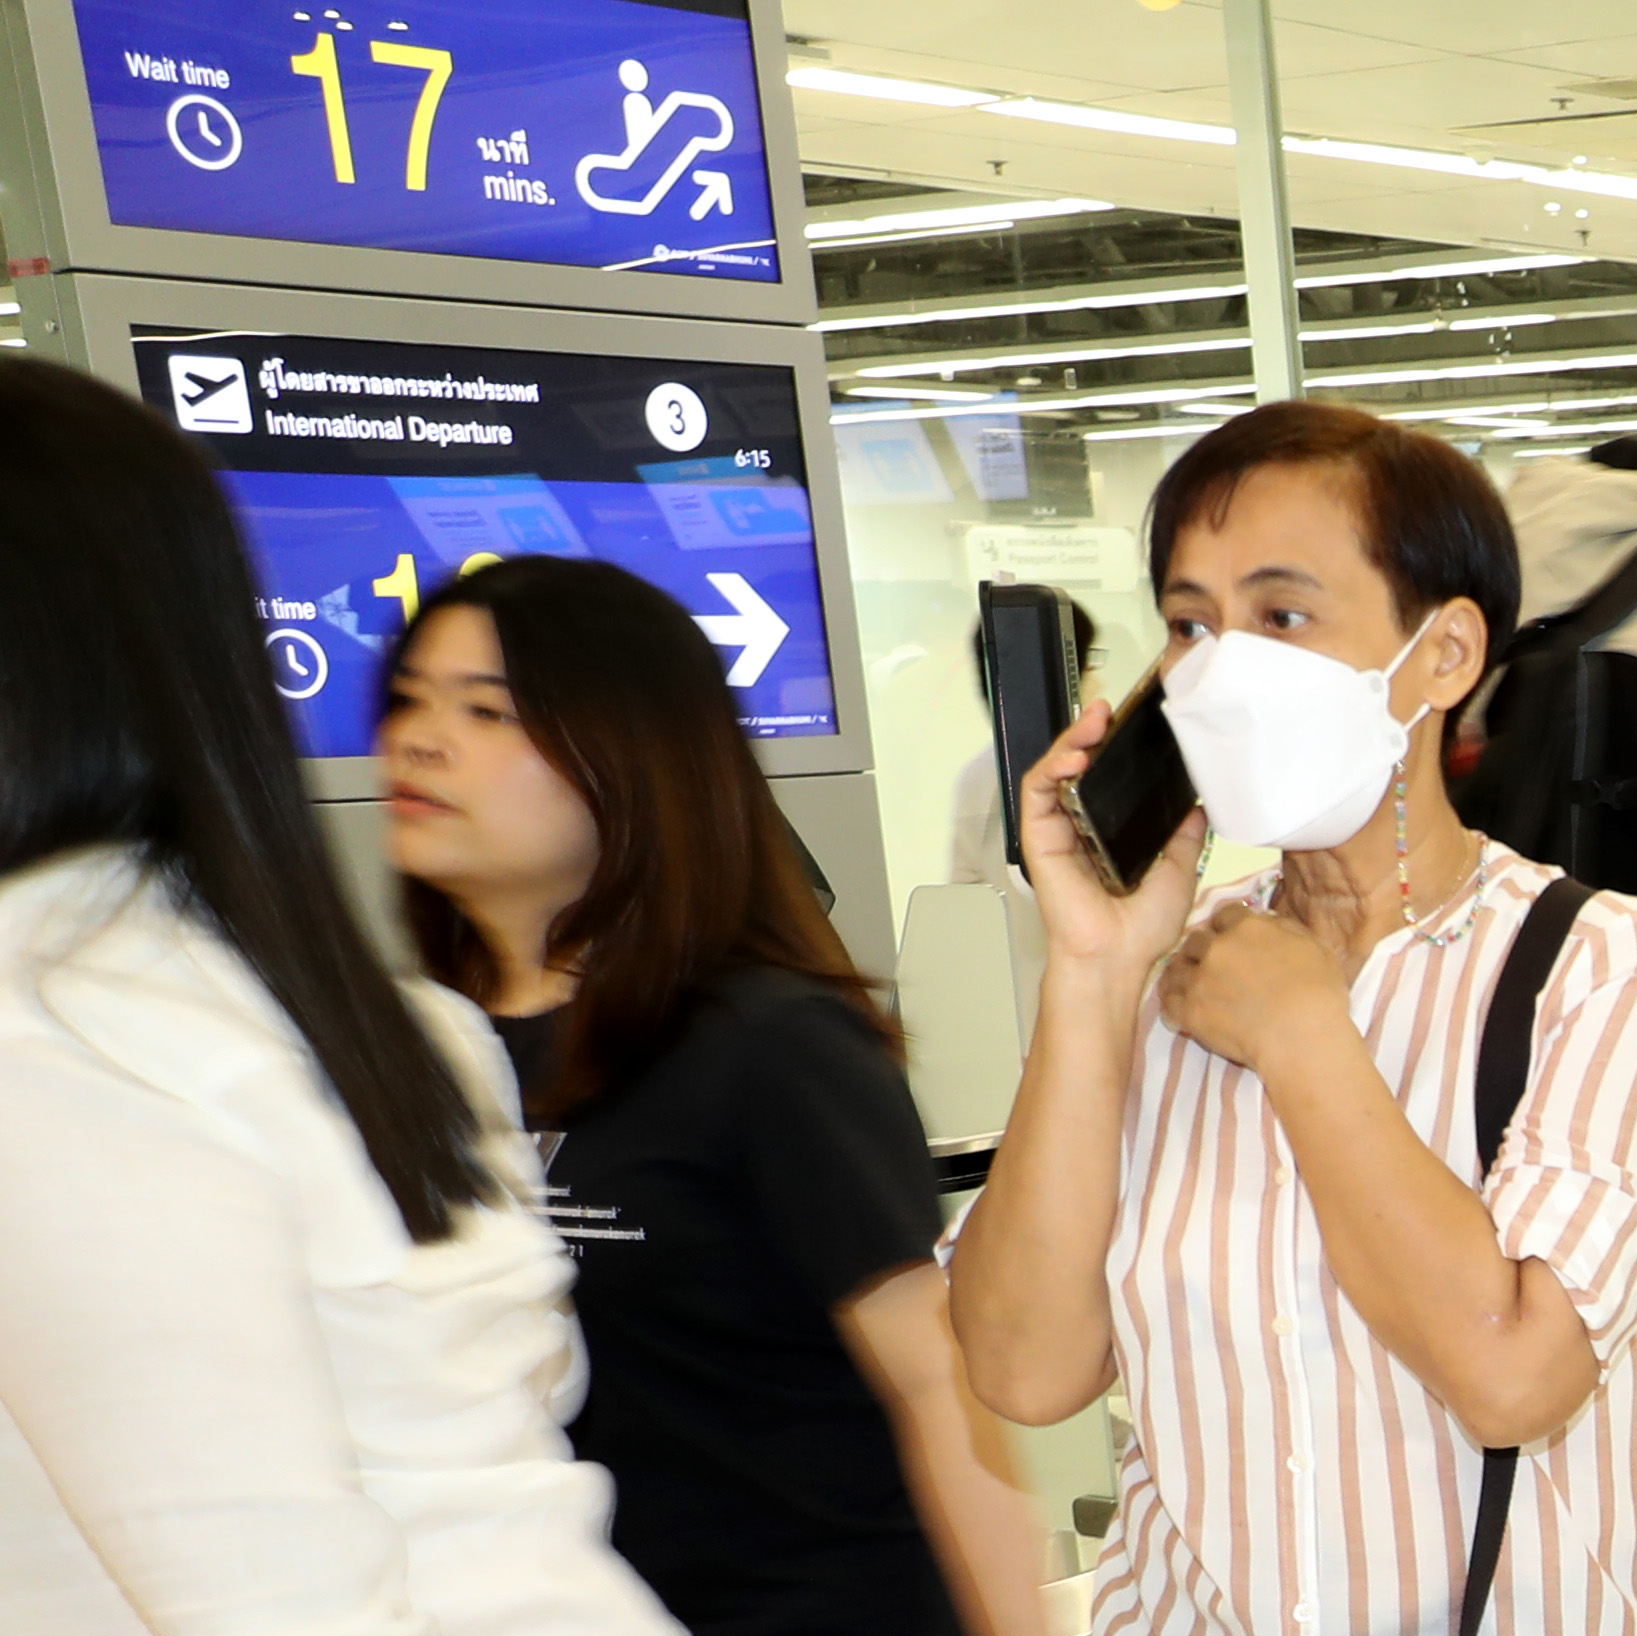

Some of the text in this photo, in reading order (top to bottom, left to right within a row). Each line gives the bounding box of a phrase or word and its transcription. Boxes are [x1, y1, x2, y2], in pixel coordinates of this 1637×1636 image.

[124, 51, 230, 89] Wait time
[291, 32, 453, 191] 17
[477, 129, 529, 165] นาที
[483, 171, 556, 206] mins.
[265, 410, 513, 447] International Departure
[667, 399, 686, 435] 3
[734, 448, 772, 468] 6:15
[271, 597, 317, 620] time
